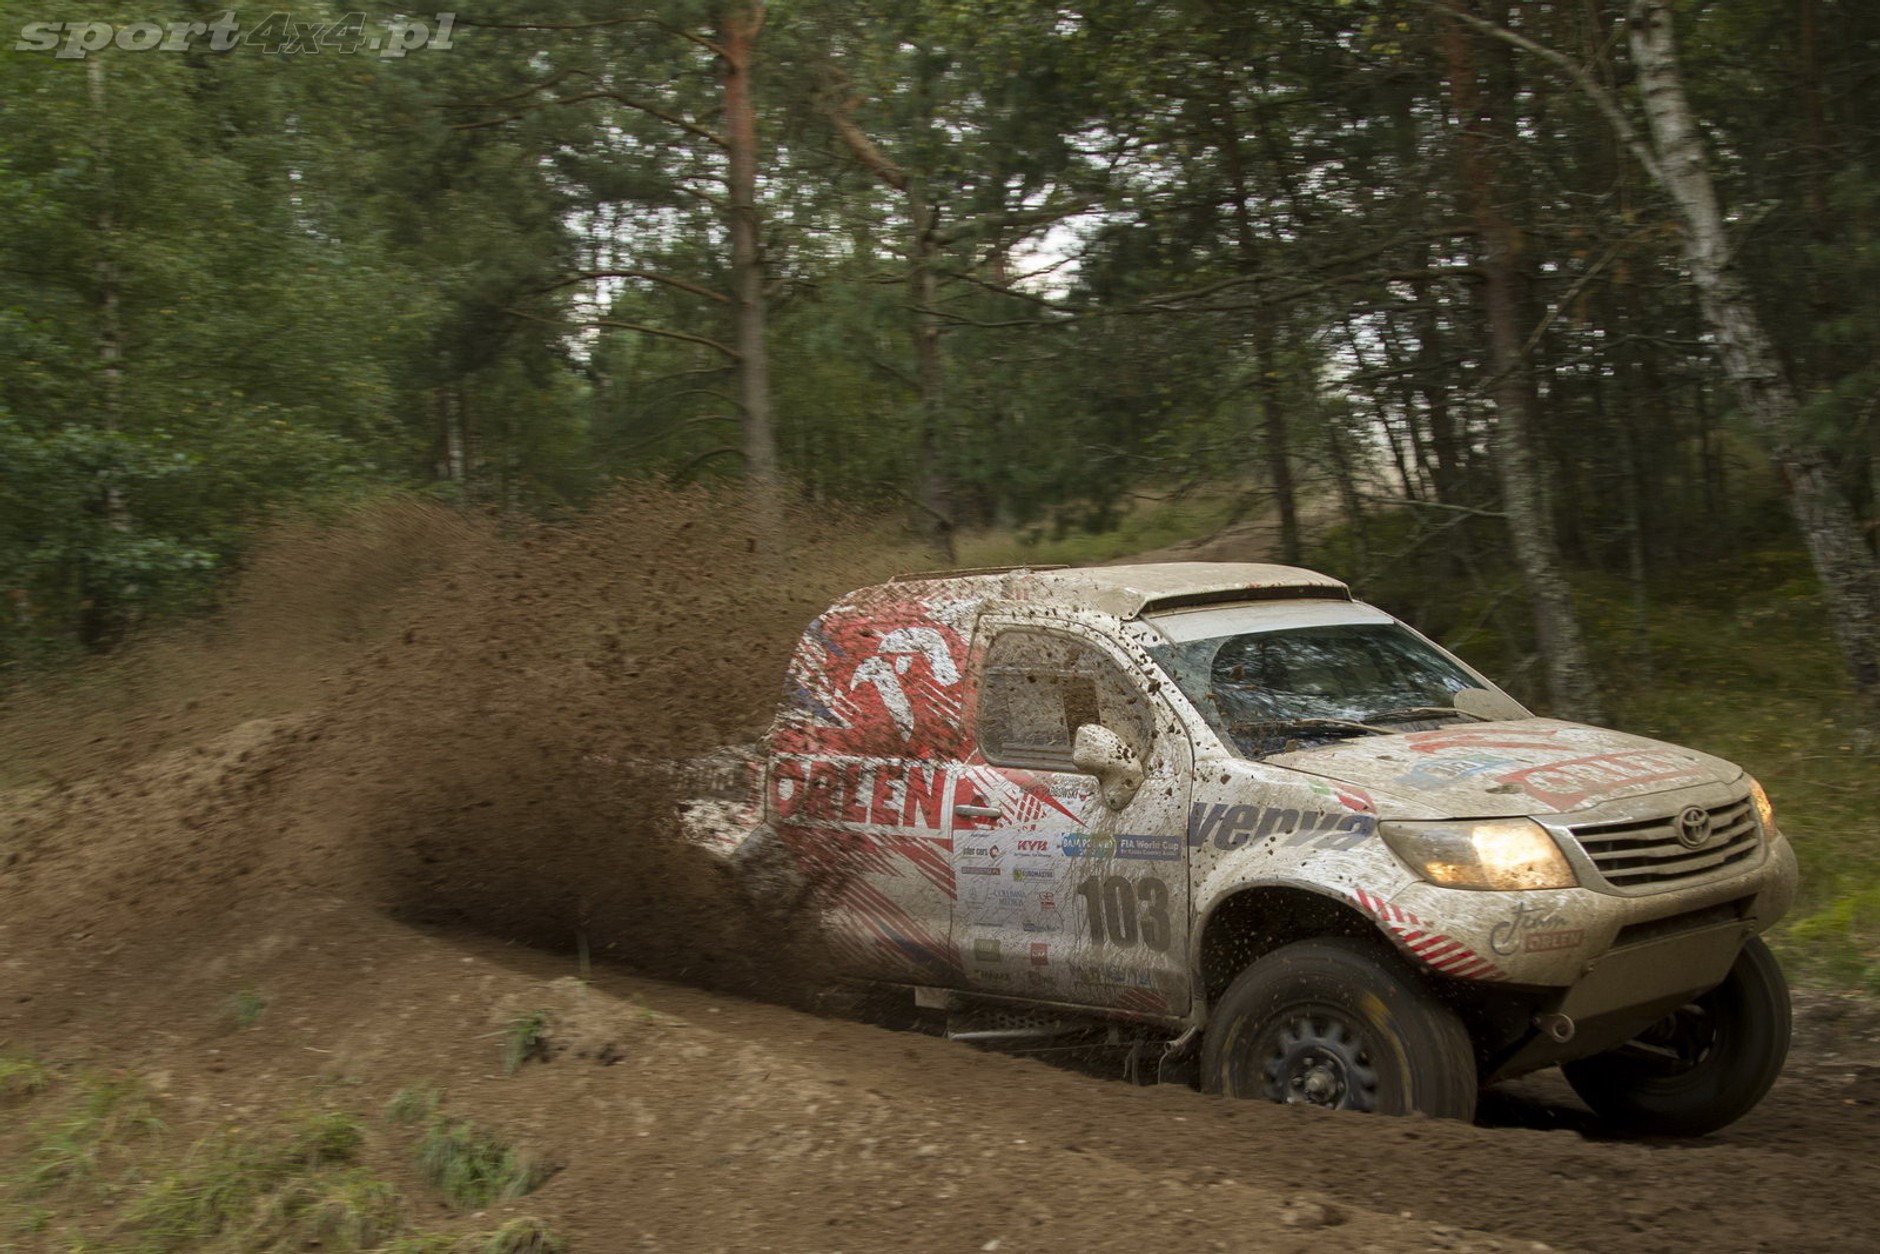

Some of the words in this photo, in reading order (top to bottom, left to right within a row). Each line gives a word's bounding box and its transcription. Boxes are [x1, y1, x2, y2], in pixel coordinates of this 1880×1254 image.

[773, 758, 947, 830] ORLEN
[1017, 840, 1048, 851] KYB
[1120, 839, 1135, 849] FIA
[1136, 840, 1160, 851] World
[1162, 841, 1179, 852] Cup
[1187, 801, 1377, 851] verva
[1077, 875, 1171, 953] 103
